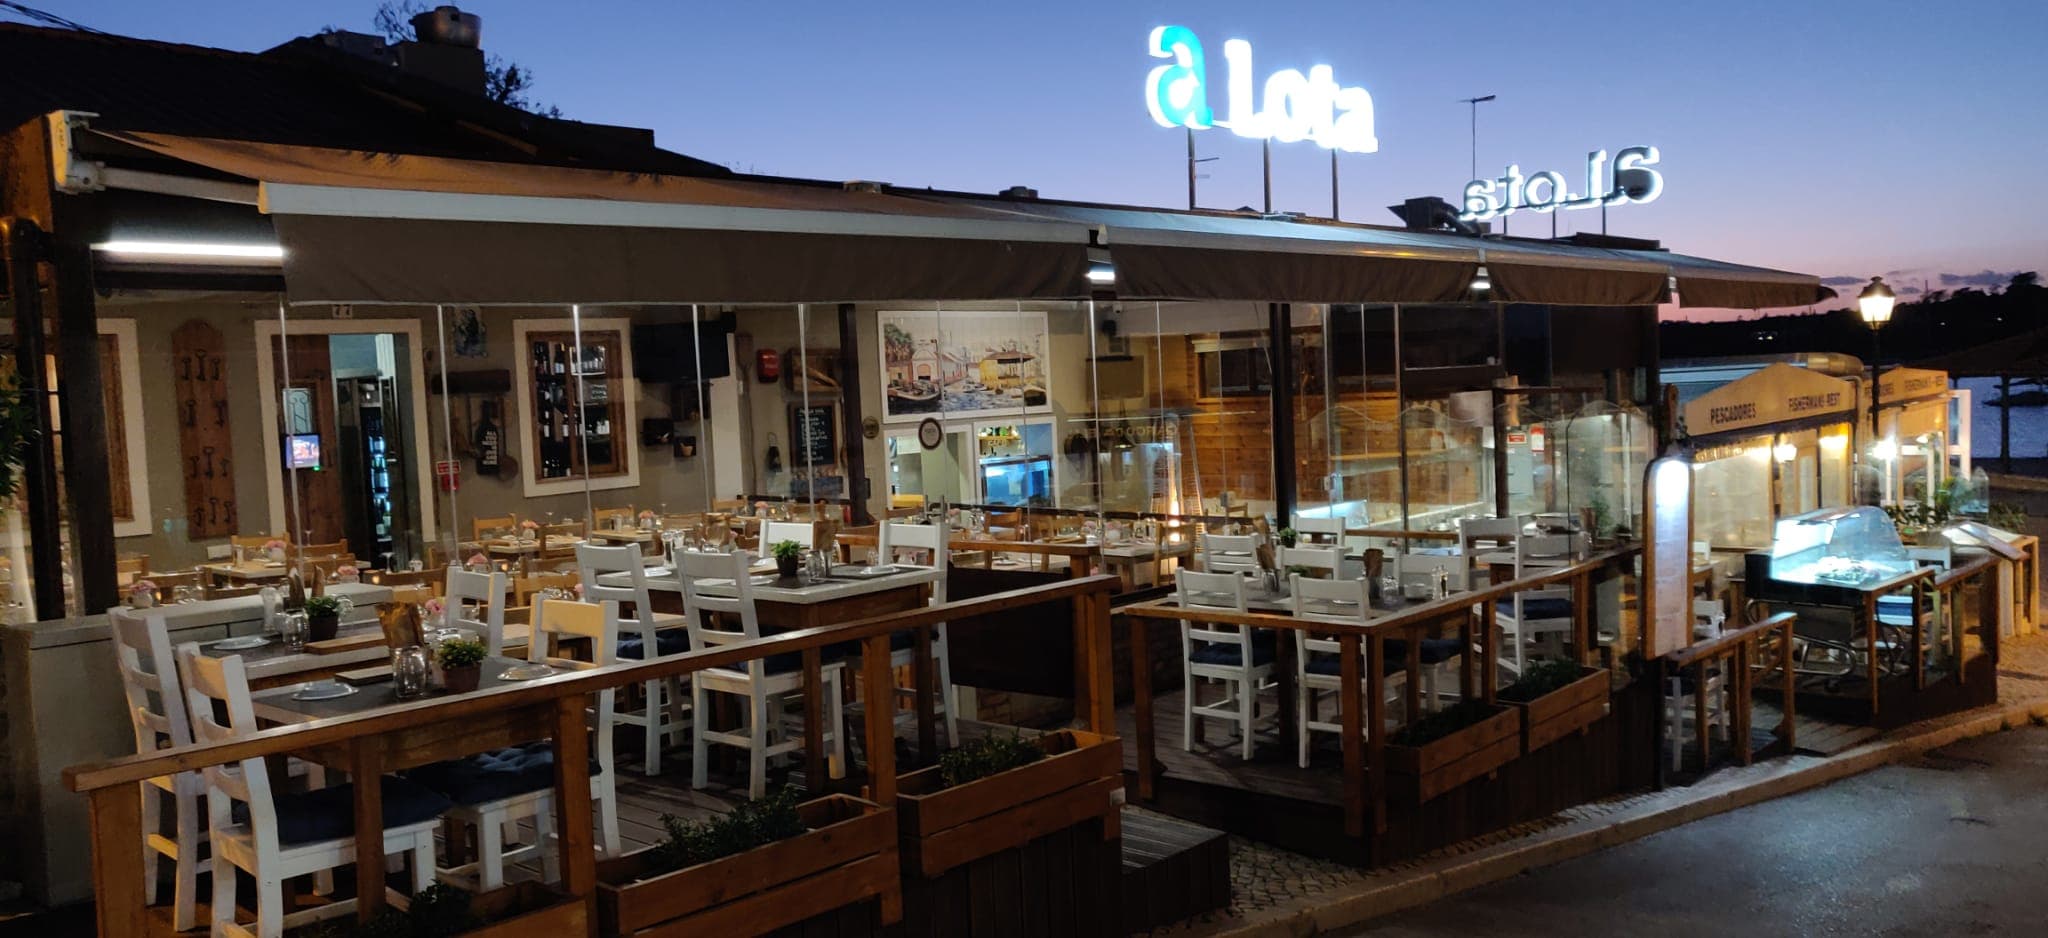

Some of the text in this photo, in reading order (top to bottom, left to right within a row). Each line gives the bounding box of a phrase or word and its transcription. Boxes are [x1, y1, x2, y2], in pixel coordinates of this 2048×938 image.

[1146, 25, 1379, 153] a Lota
[1710, 402, 1756, 425] PESCADORES
